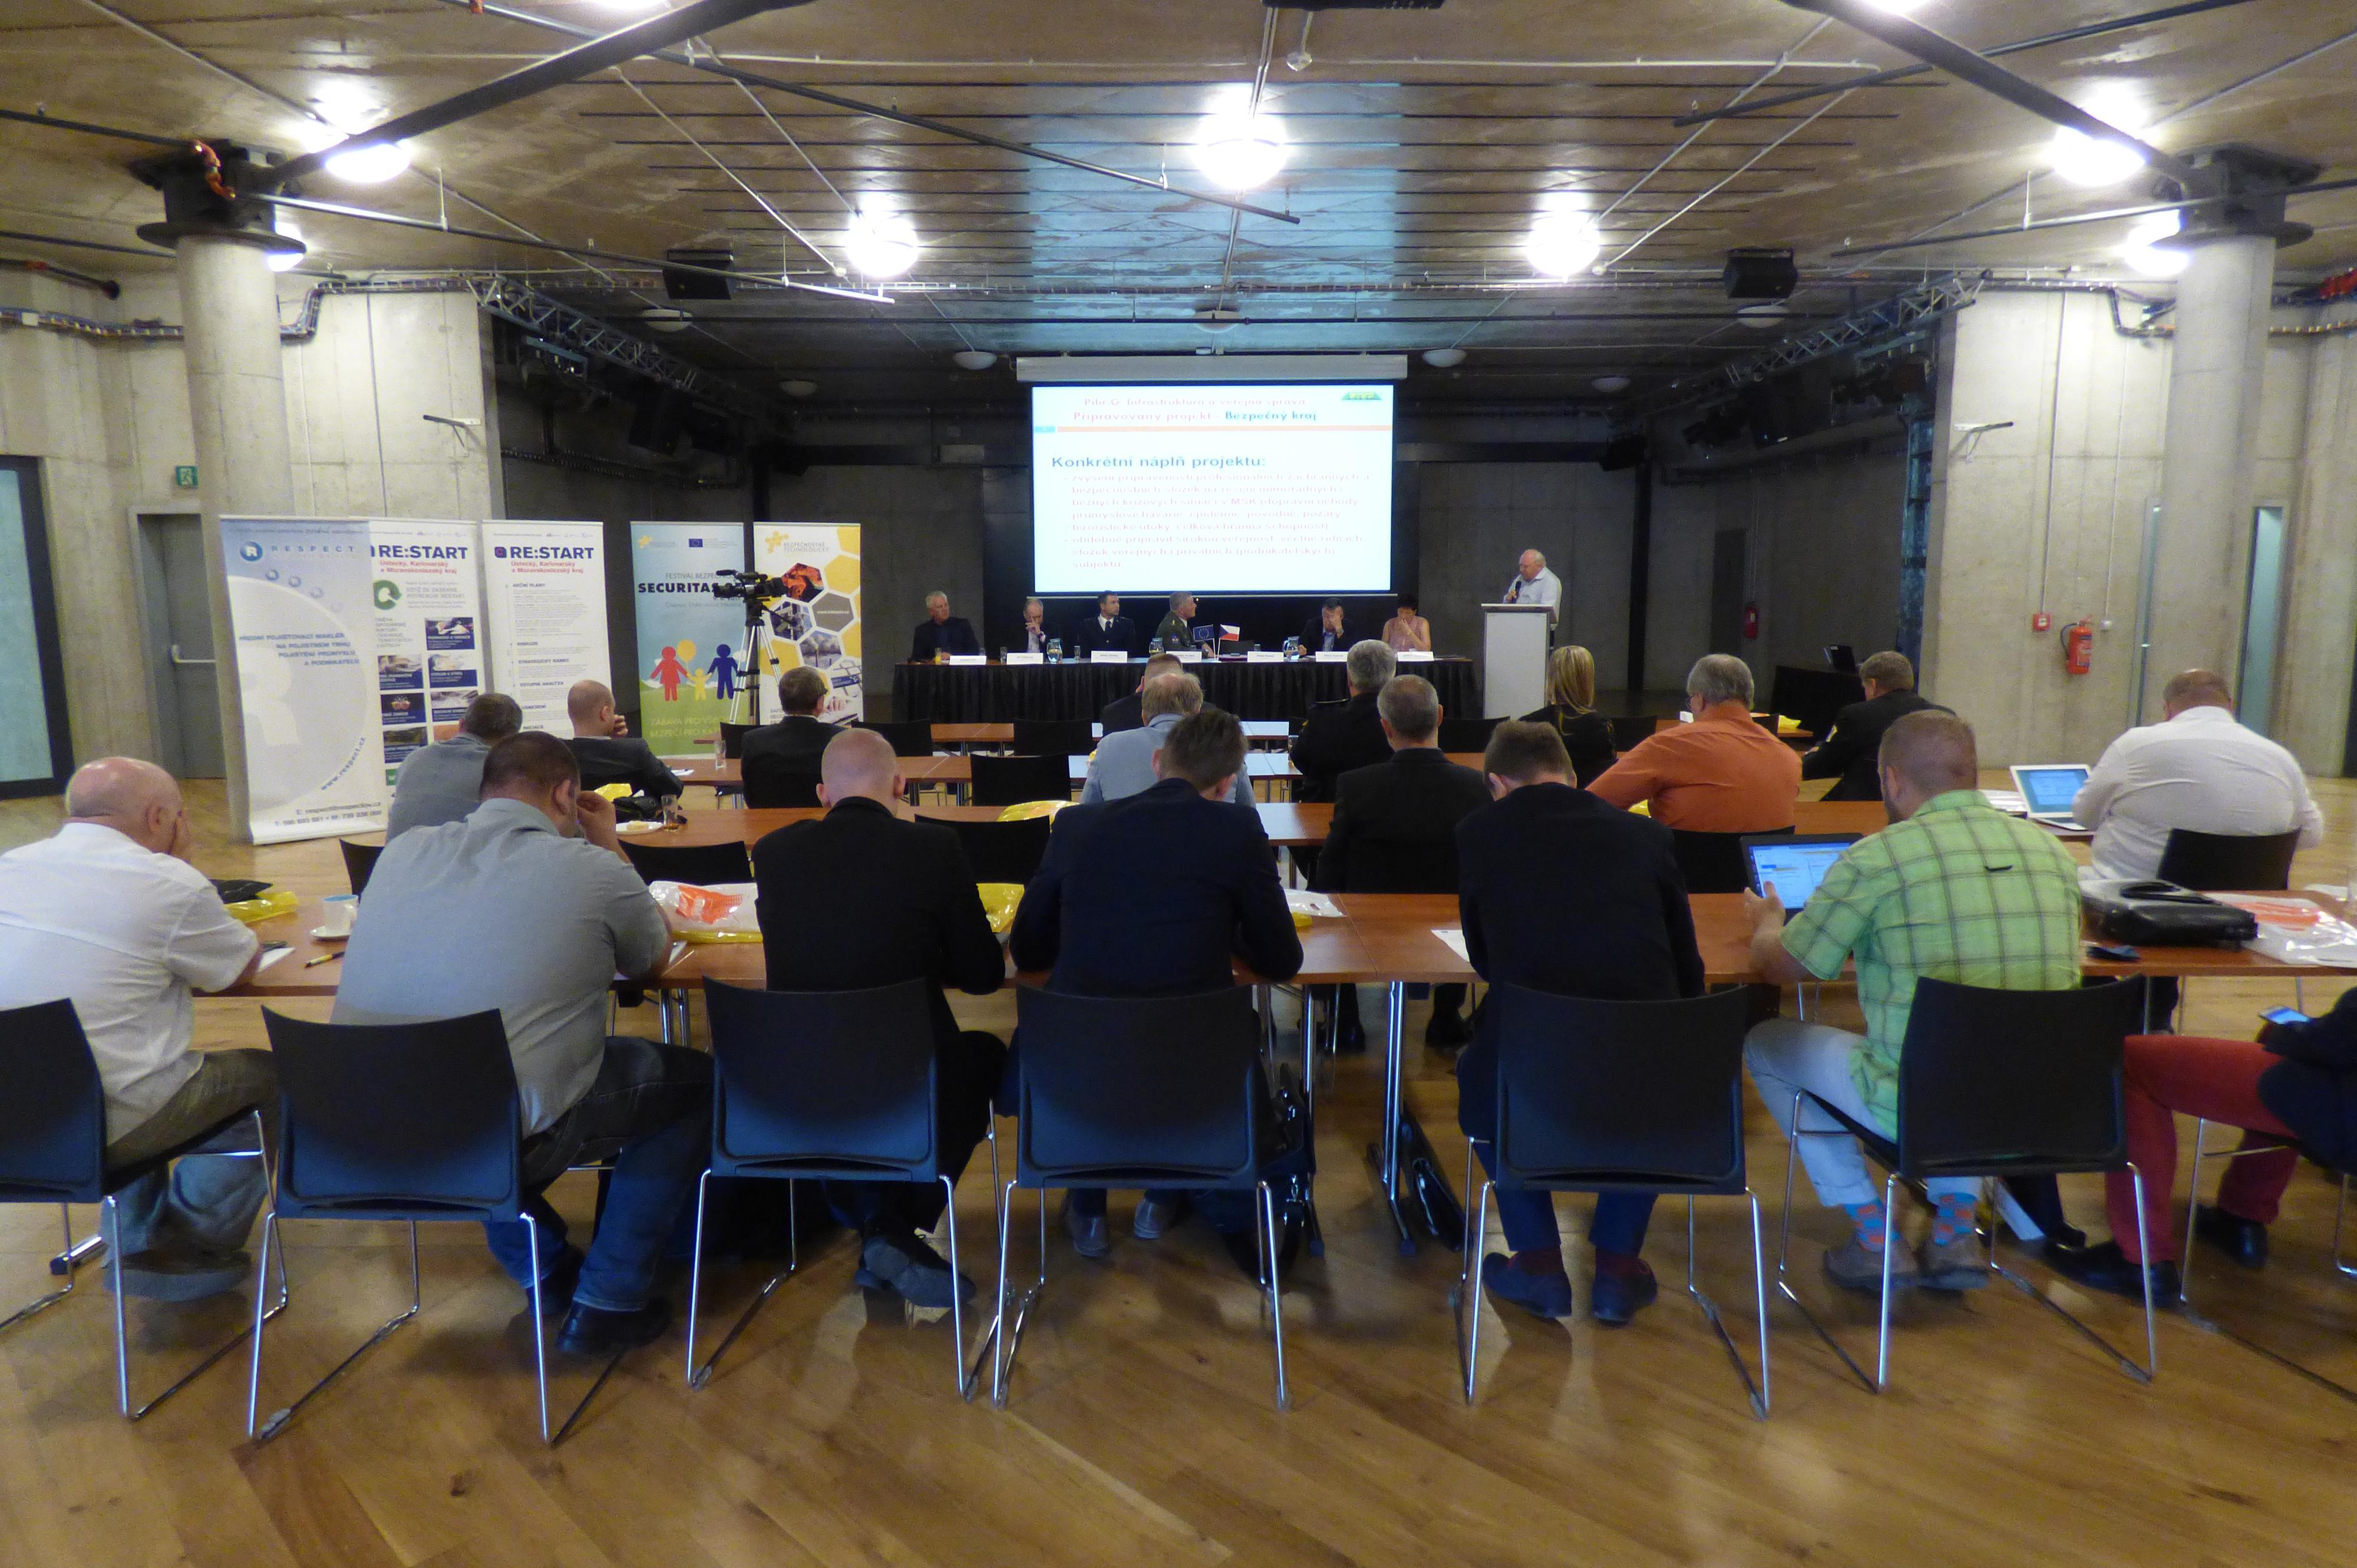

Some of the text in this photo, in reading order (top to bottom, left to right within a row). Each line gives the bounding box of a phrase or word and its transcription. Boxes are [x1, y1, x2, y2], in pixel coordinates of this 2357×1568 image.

[1292, 411, 1316, 421] kraj
[1052, 455, 1265, 468] Konkrétní náplň projektu:
[271, 544, 356, 553] RESPECT
[379, 544, 468, 559] RE:START
[510, 546, 594, 559] RE:START
